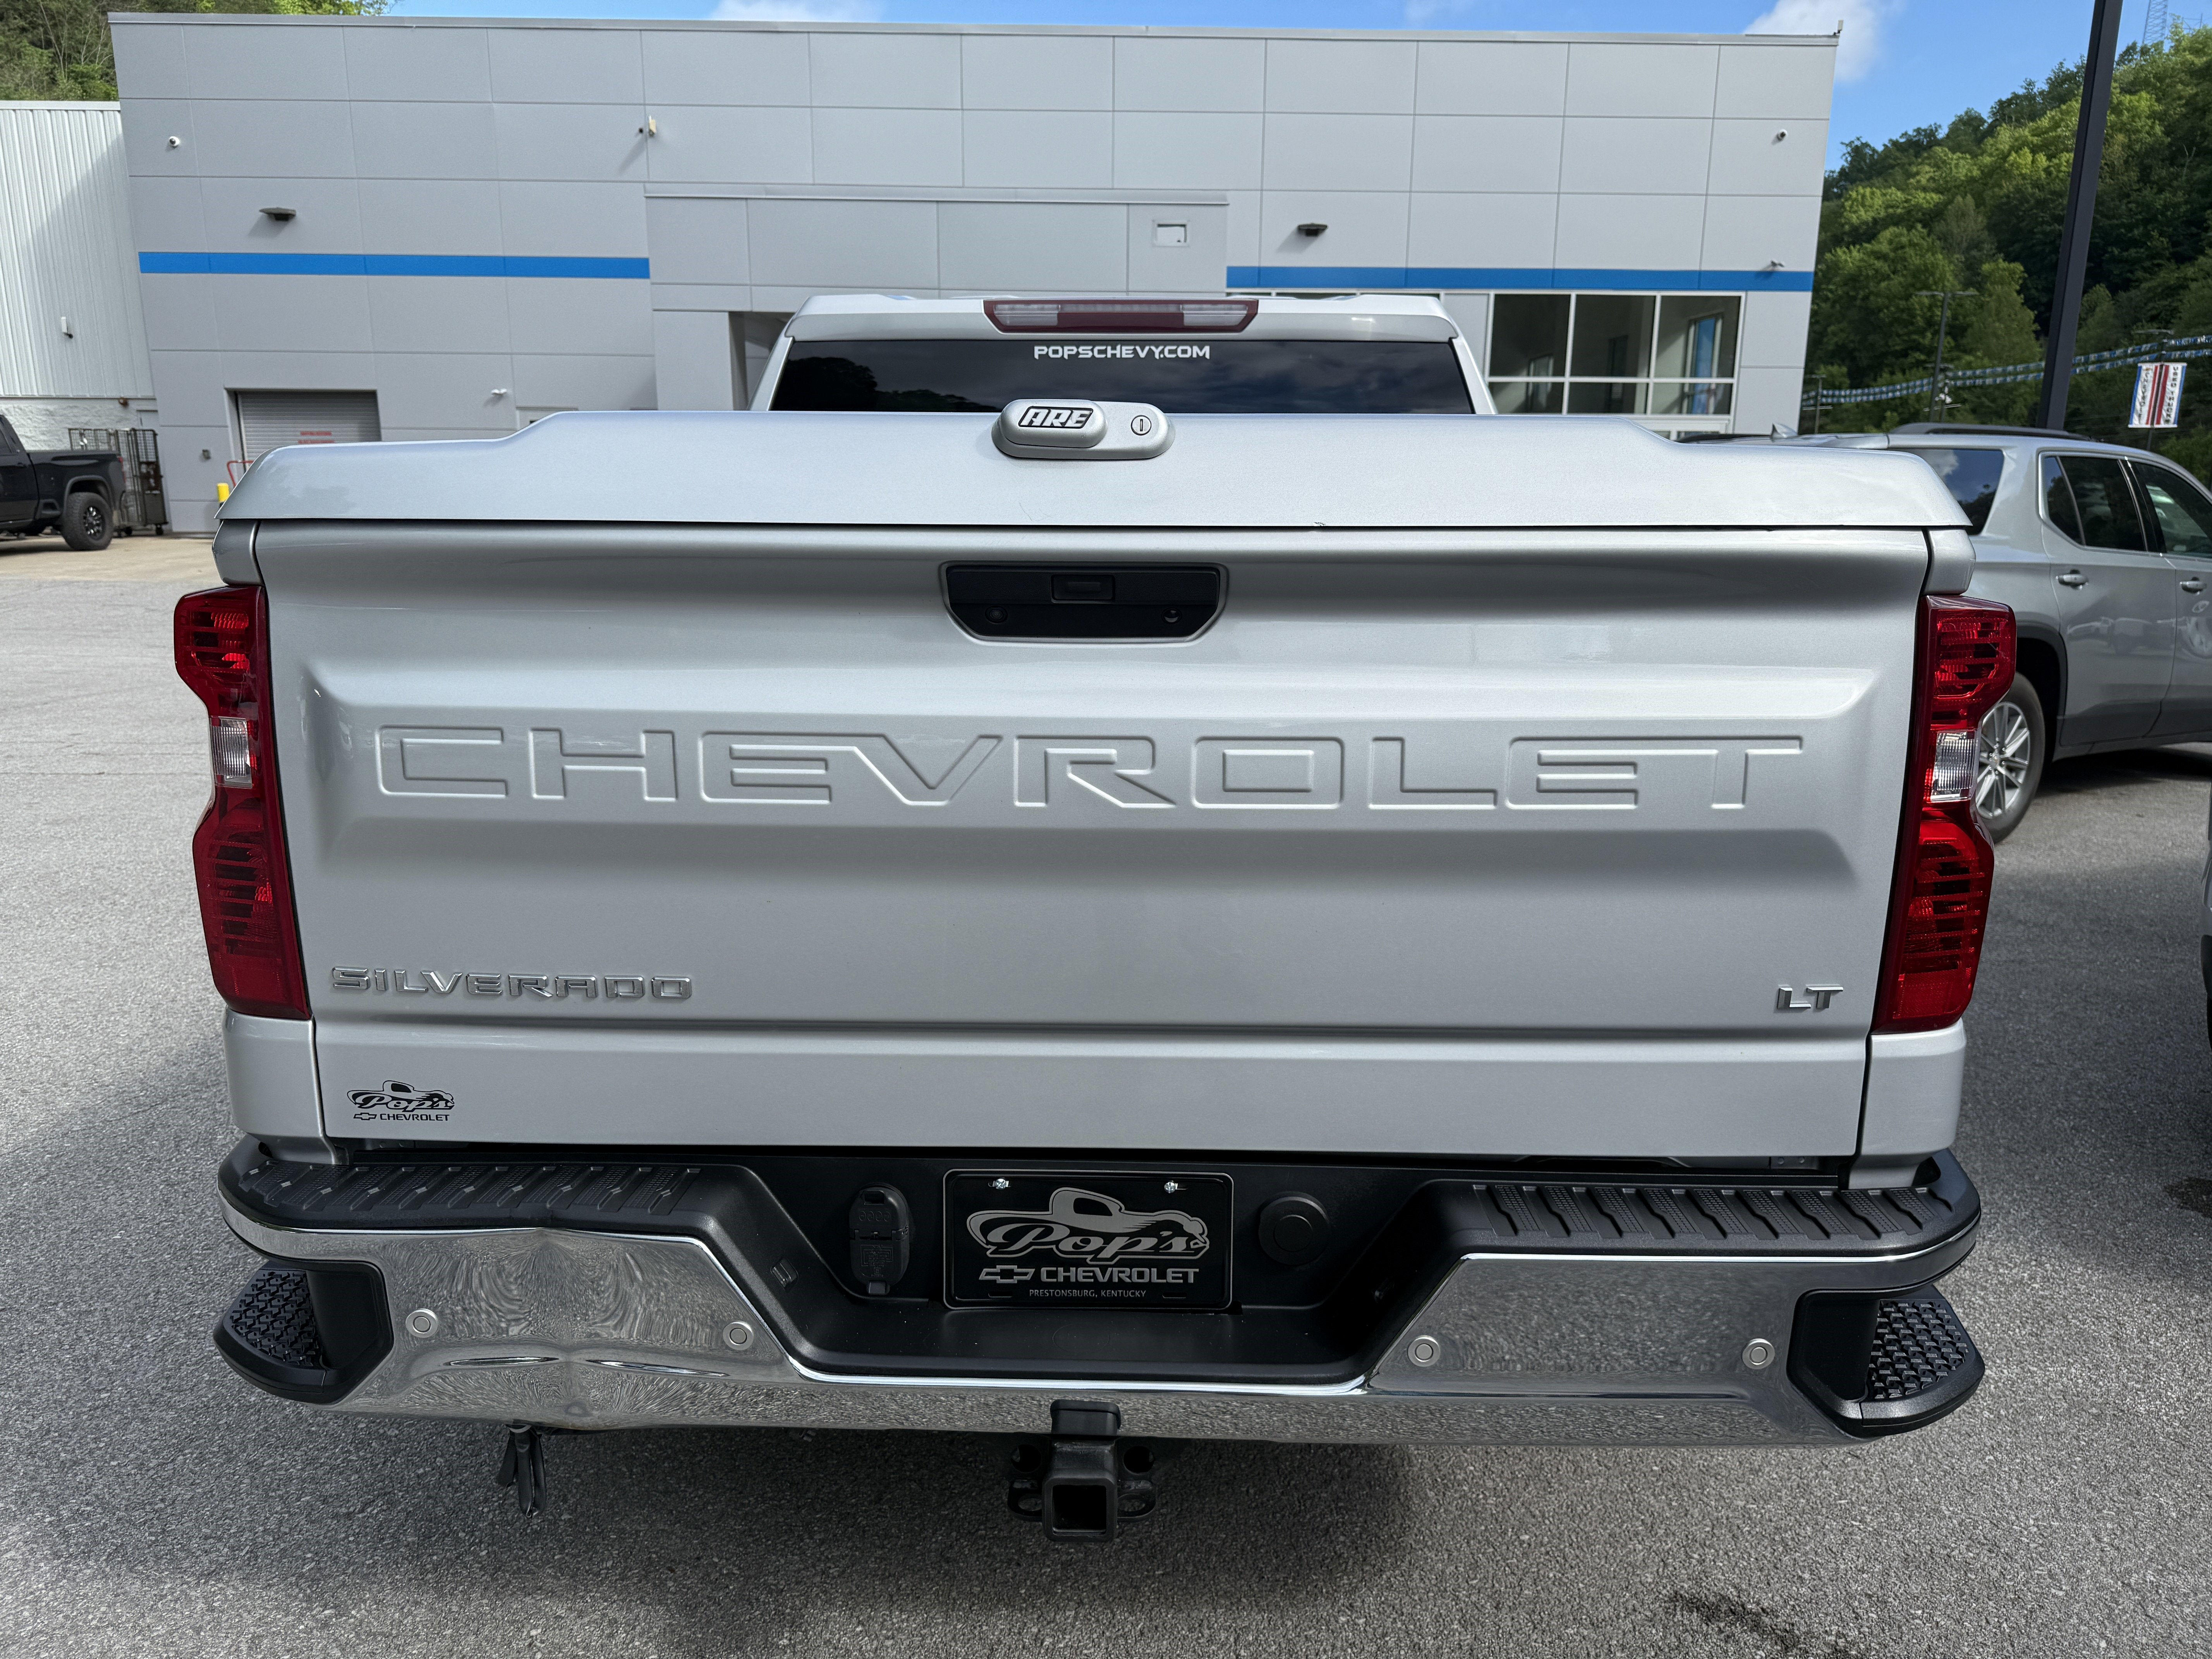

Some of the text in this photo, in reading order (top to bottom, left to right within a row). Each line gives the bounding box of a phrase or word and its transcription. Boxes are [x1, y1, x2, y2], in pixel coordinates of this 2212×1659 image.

[1034, 344, 1210, 359] POPSCHEVY.COM
[1020, 408, 1092, 427] ARE
[374, 724, 1804, 809] CHEVROLET
[331, 967, 692, 999] SILVERADO
[1777, 986, 1844, 1009] LT
[355, 1093, 450, 1111] Pop's
[986, 1223, 1195, 1259] Pop's
[1040, 1267, 1199, 1283] CHEVROLET
[1029, 1289, 1098, 1298] PRESTONSBURG,
